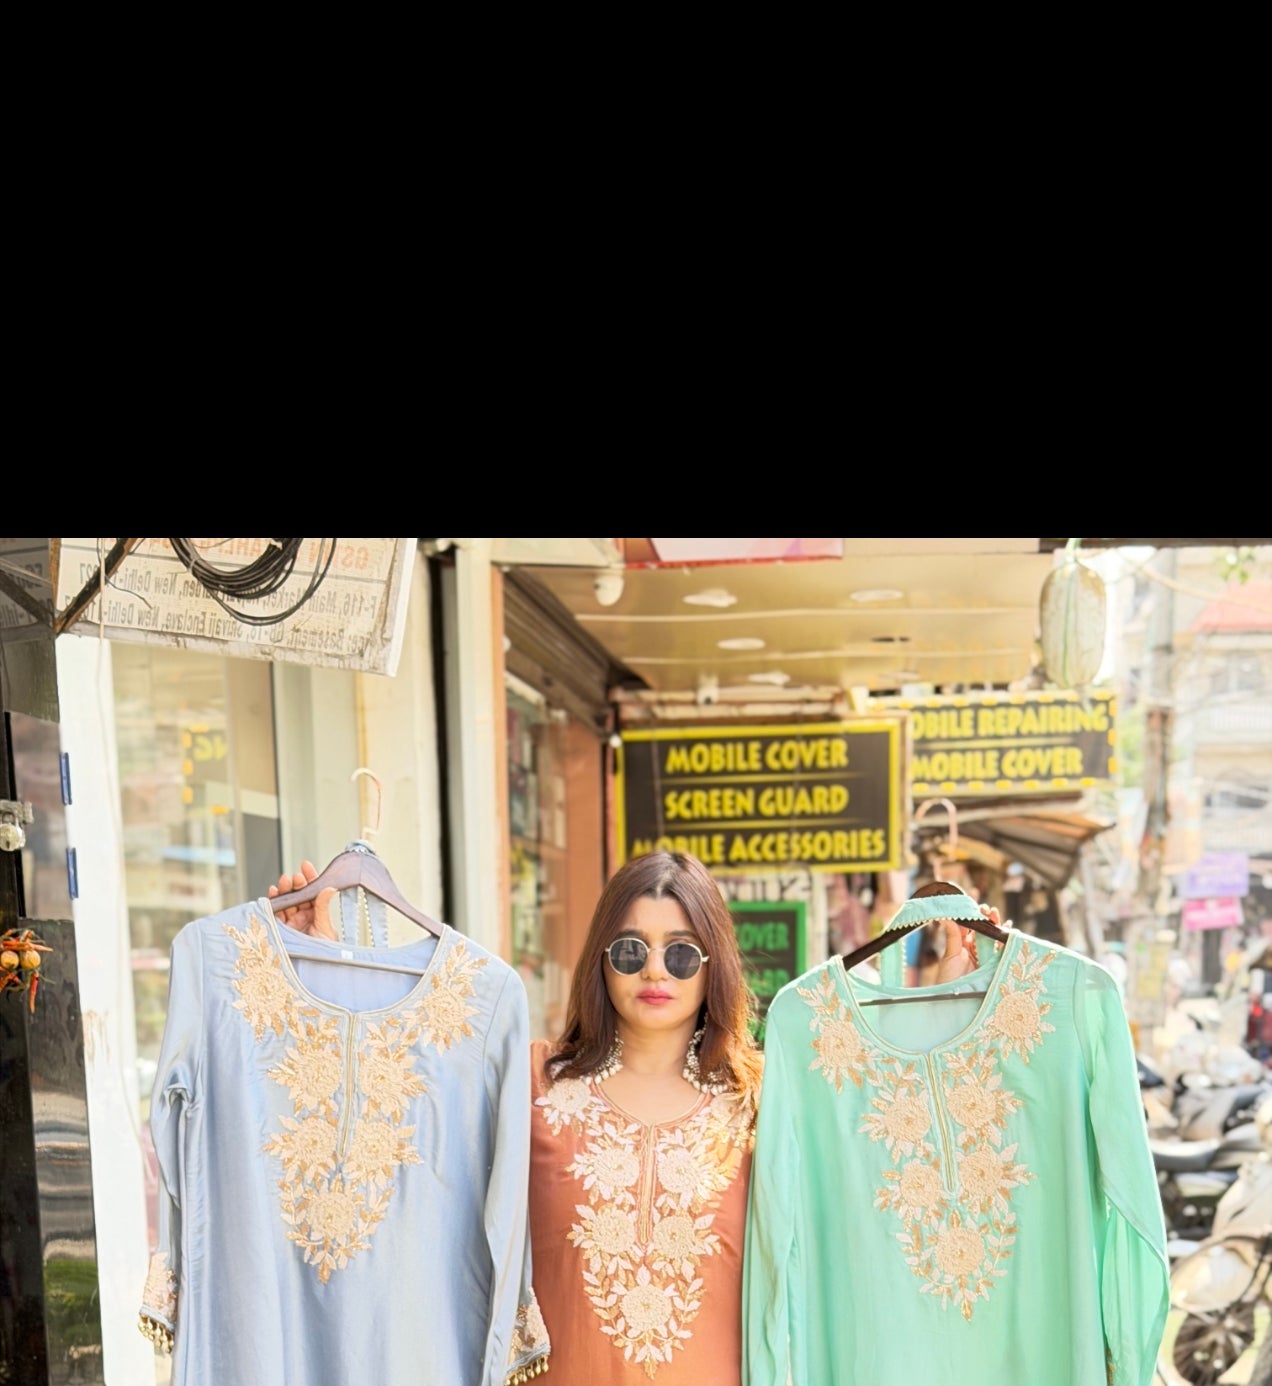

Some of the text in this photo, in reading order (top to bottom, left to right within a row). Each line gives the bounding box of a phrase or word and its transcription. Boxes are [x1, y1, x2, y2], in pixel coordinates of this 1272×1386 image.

[911, 703, 1108, 740] OBILE REPAIRING
[665, 738, 849, 774] MOBILE COVER
[911, 747, 1084, 781] MOBILE COVER
[664, 785, 849, 819] SCREEN GUARD
[729, 829, 885, 861] ACCESSORIES
[735, 922, 789, 951] OVER
